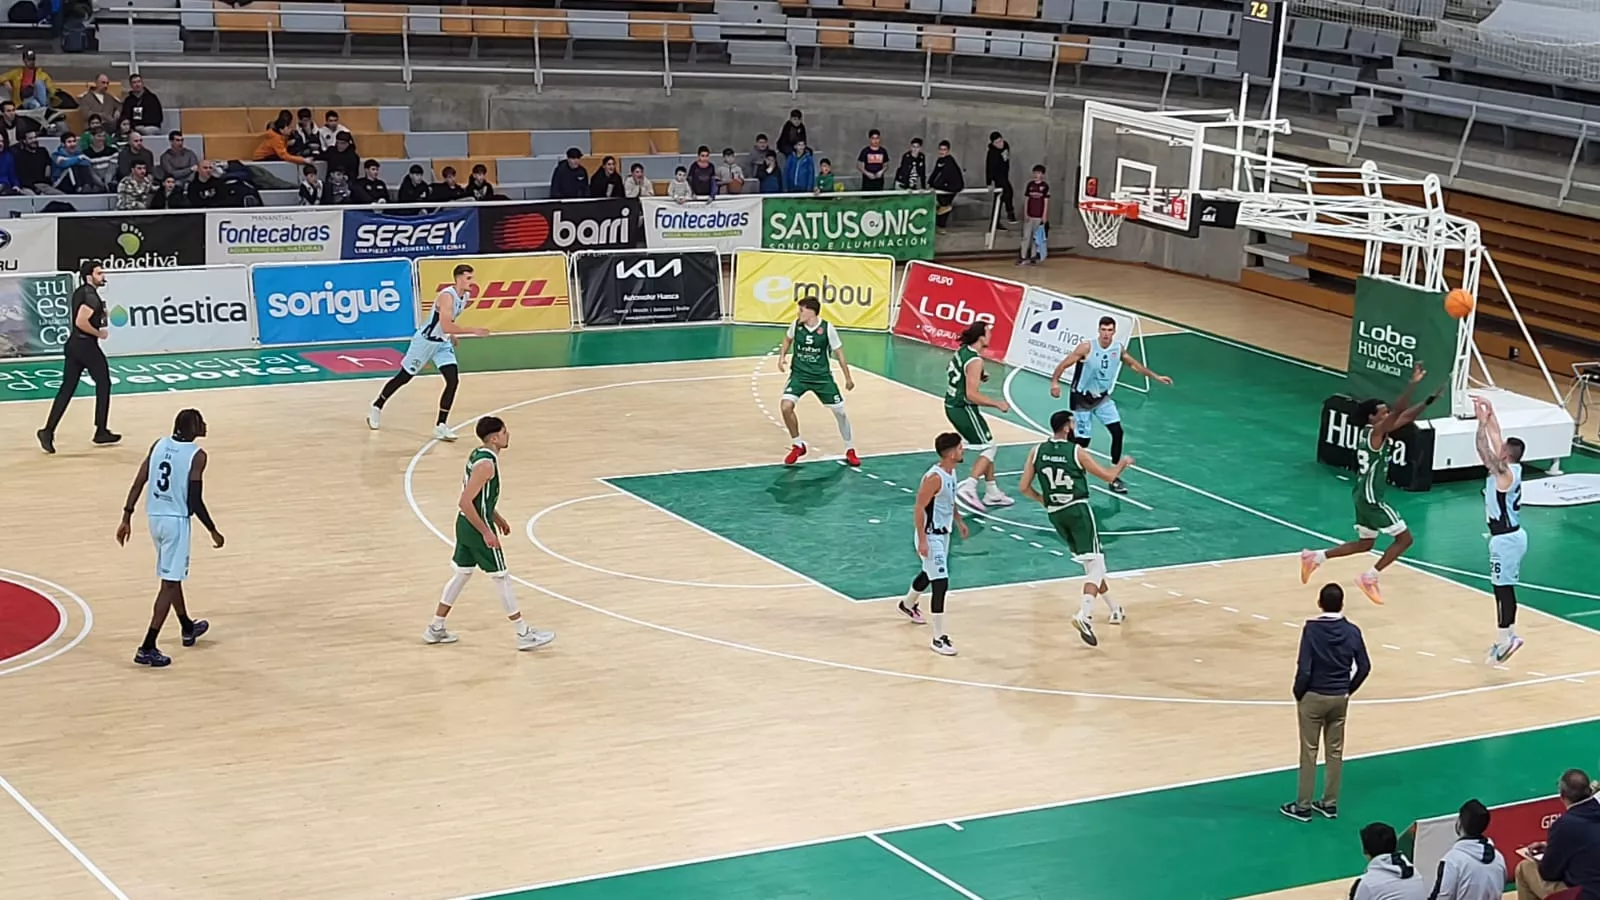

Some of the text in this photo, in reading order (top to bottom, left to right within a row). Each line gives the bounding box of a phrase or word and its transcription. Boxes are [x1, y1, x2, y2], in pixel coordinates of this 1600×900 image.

[355, 220, 466, 247] SERFEY
[553, 207, 630, 247] barri
[770, 208, 928, 240] SATUSONIC
[616, 258, 682, 279] KIA
[1359, 321, 1417, 350] Lobe
[157, 461, 171, 492] 3
[1041, 466, 1074, 490] 14
